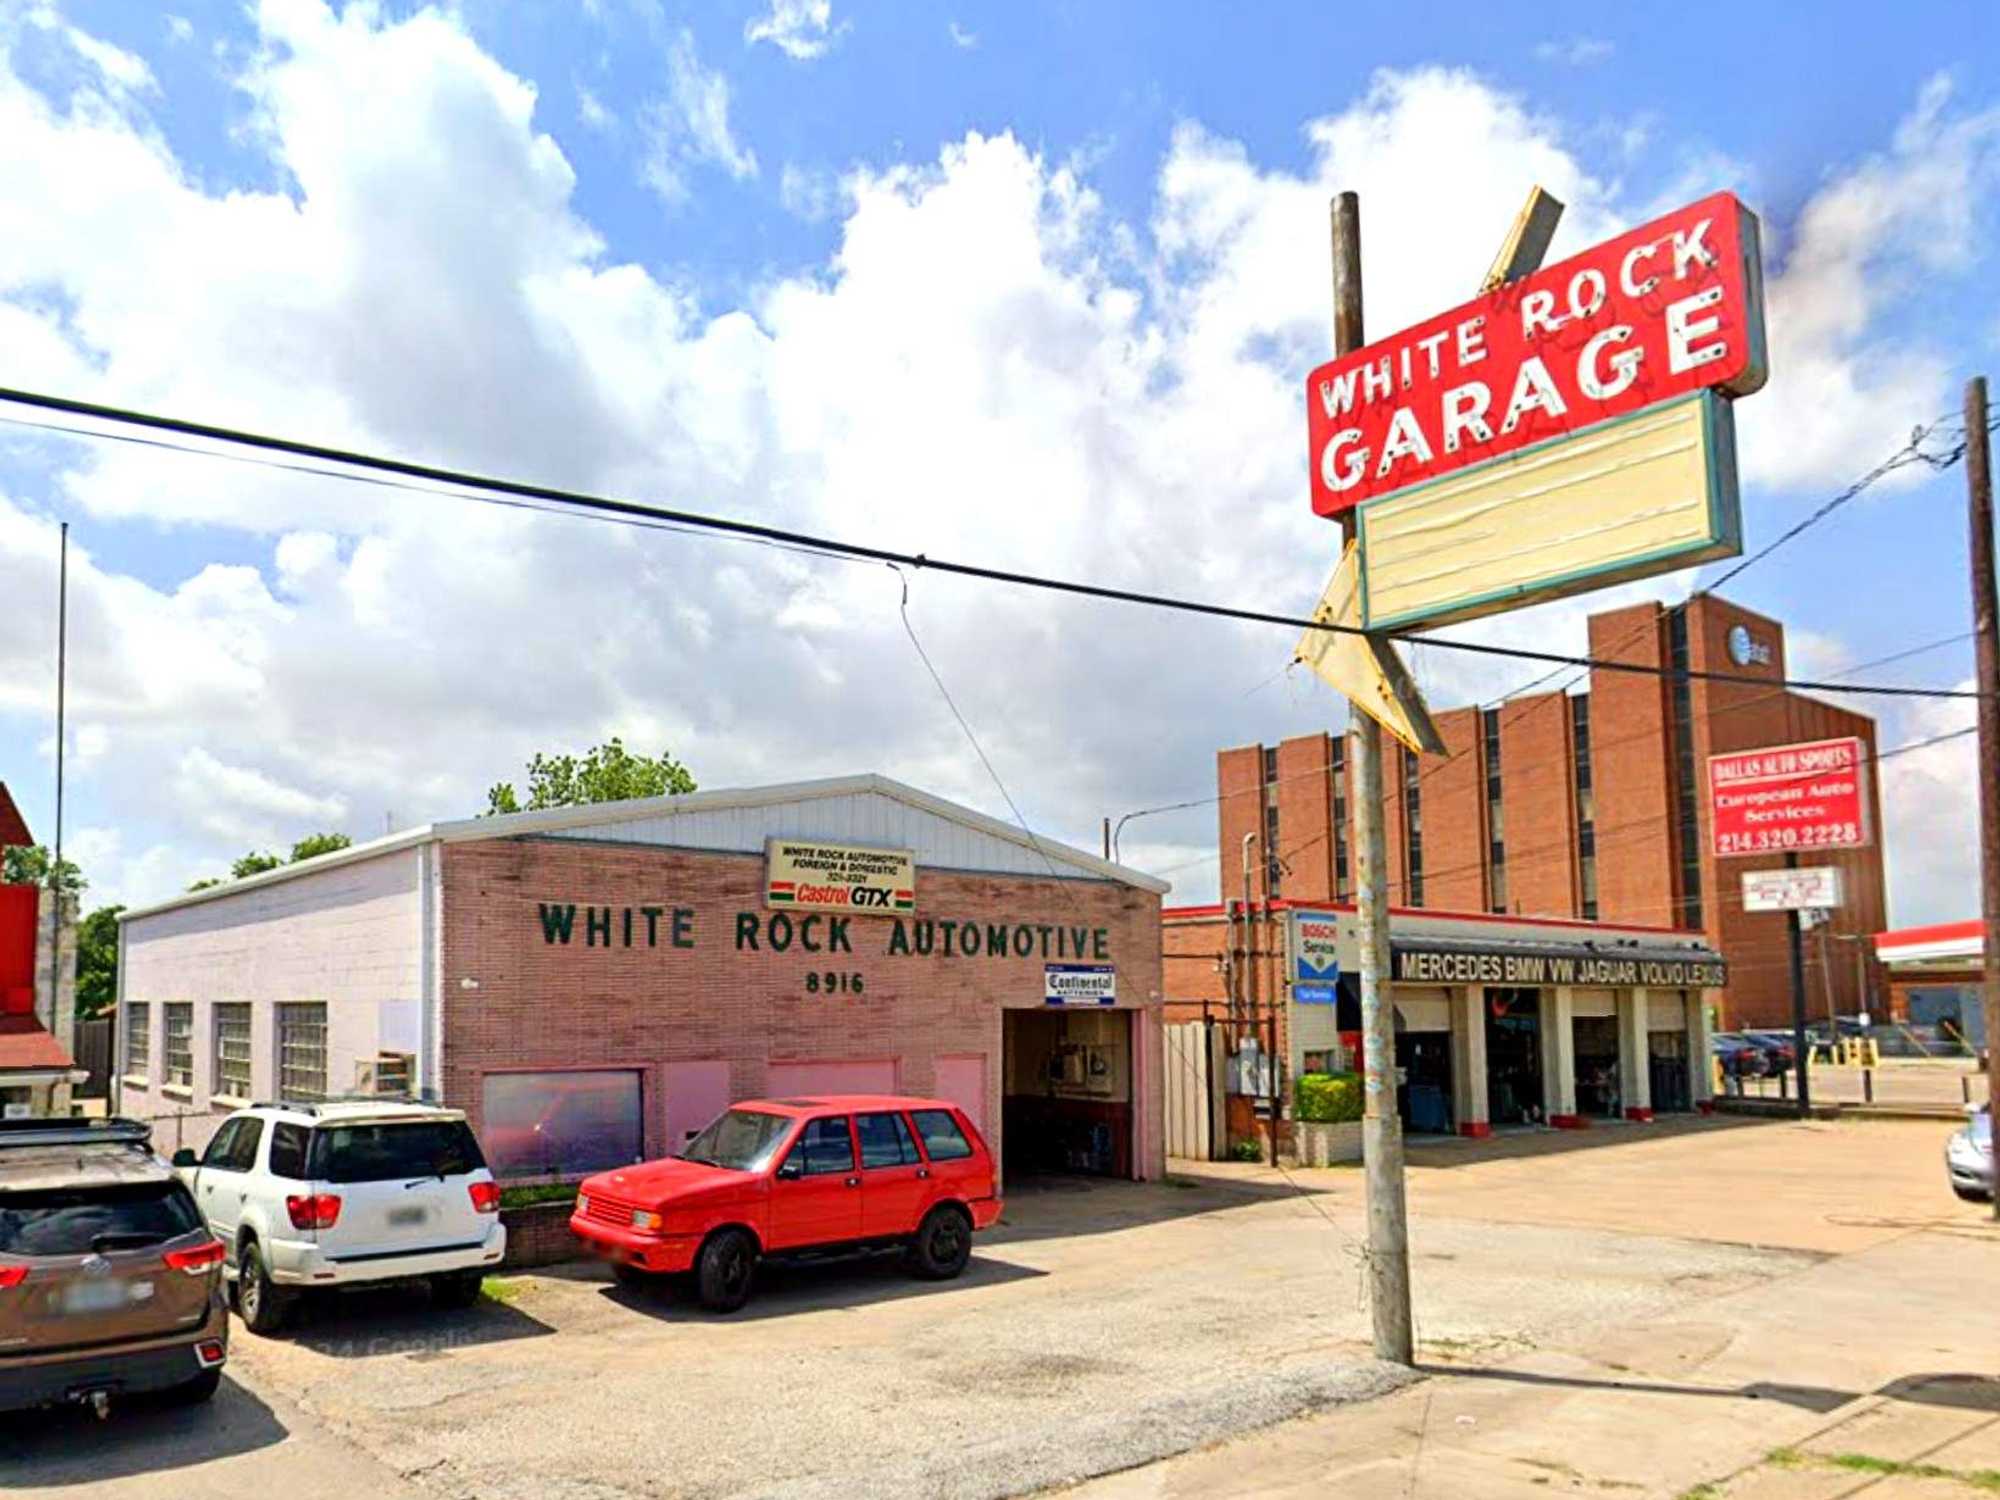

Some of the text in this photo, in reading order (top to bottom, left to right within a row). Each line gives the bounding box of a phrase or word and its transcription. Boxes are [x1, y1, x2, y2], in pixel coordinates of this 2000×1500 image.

[1320, 218, 1719, 419] WHITE ROCK
[1320, 285, 1727, 492] GARAGE
[1715, 782, 1854, 808] European Auto
[1745, 805, 1825, 823] Services
[783, 846, 907, 866] WHITE ROCK AUTOMOTIVE
[793, 858, 838, 871] FOREIGN
[848, 863, 898, 876] DOMESTIC
[797, 882, 892, 907] Castrol GTX
[538, 902, 1110, 960] WHITE ROCK AUTOMOTIVE
[1302, 923, 1338, 940] BOSCH
[1401, 952, 1502, 981] MERCEDES
[1505, 955, 1544, 982] BMW
[1549, 957, 1575, 982] VW
[1578, 959, 1638, 984] JAGUAR
[1639, 961, 1684, 985] VOLVO
[805, 971, 864, 994] 8916
